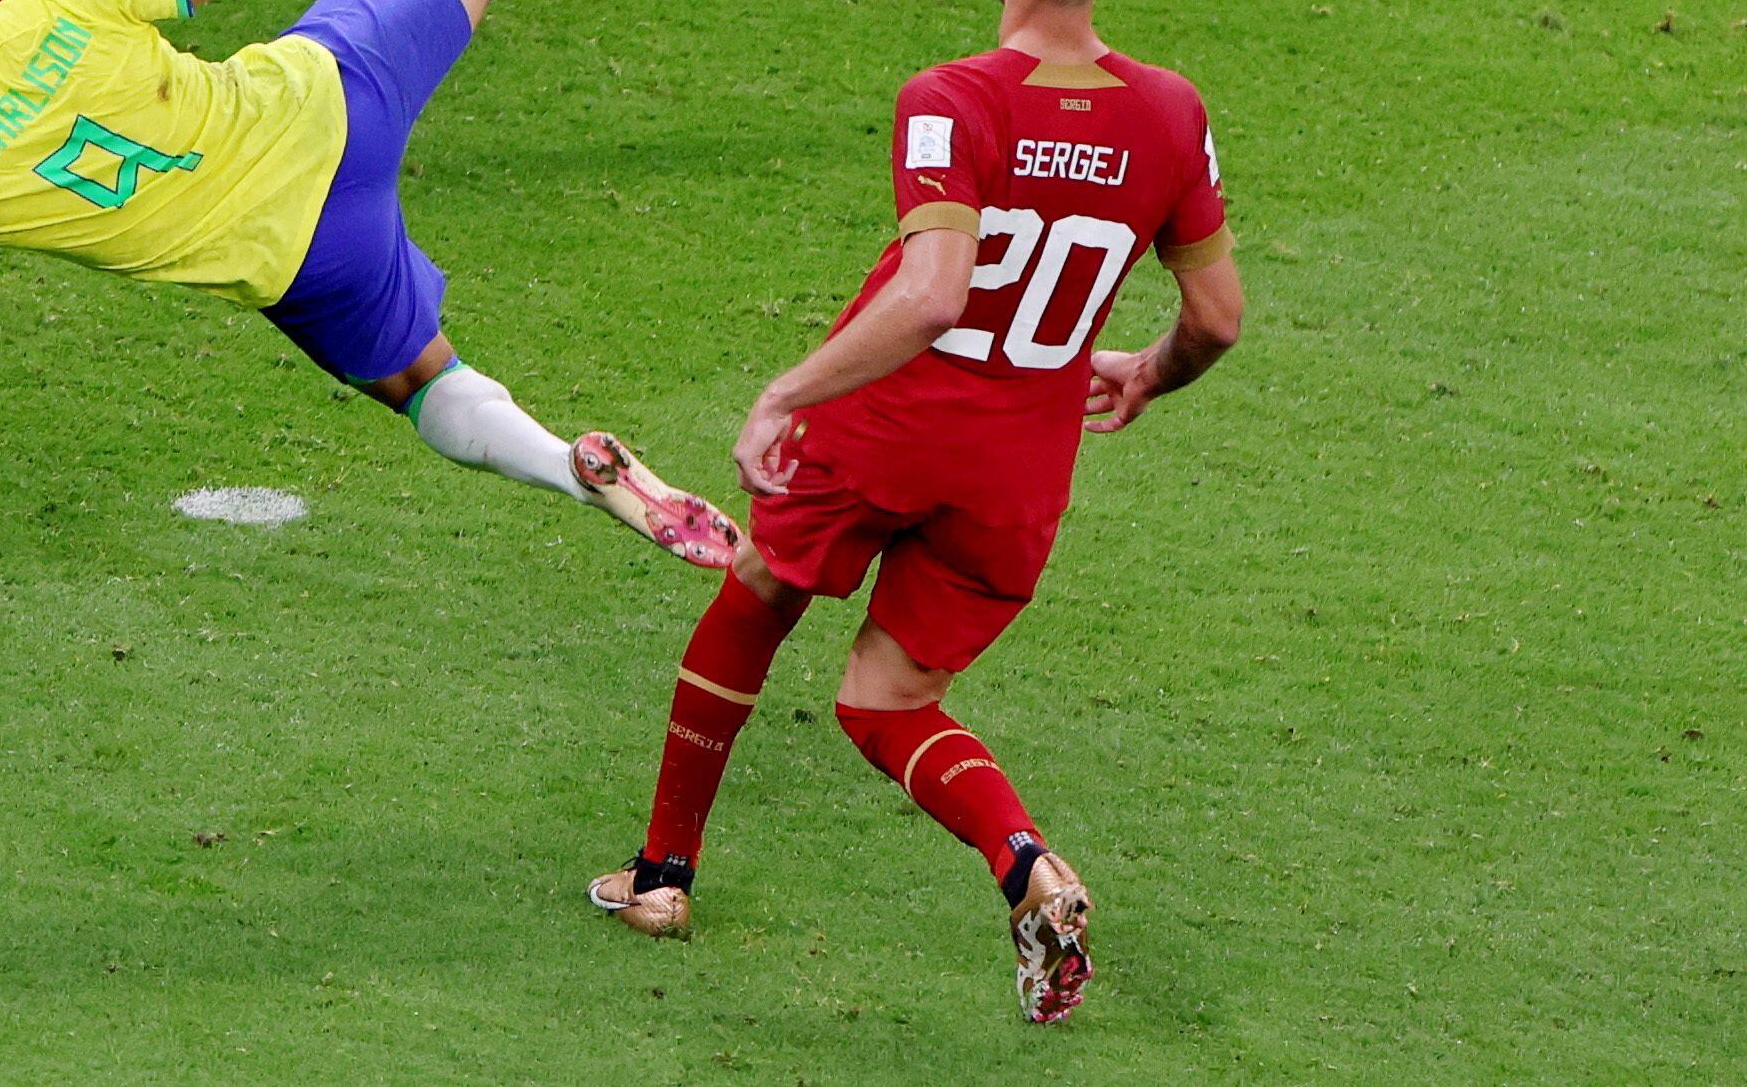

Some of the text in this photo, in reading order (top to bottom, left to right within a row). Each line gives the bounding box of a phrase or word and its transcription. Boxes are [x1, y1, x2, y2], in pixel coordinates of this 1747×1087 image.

[32, 114, 204, 209] 9
[1013, 138, 1130, 186] SERGEJ
[930, 205, 1138, 370] 20
